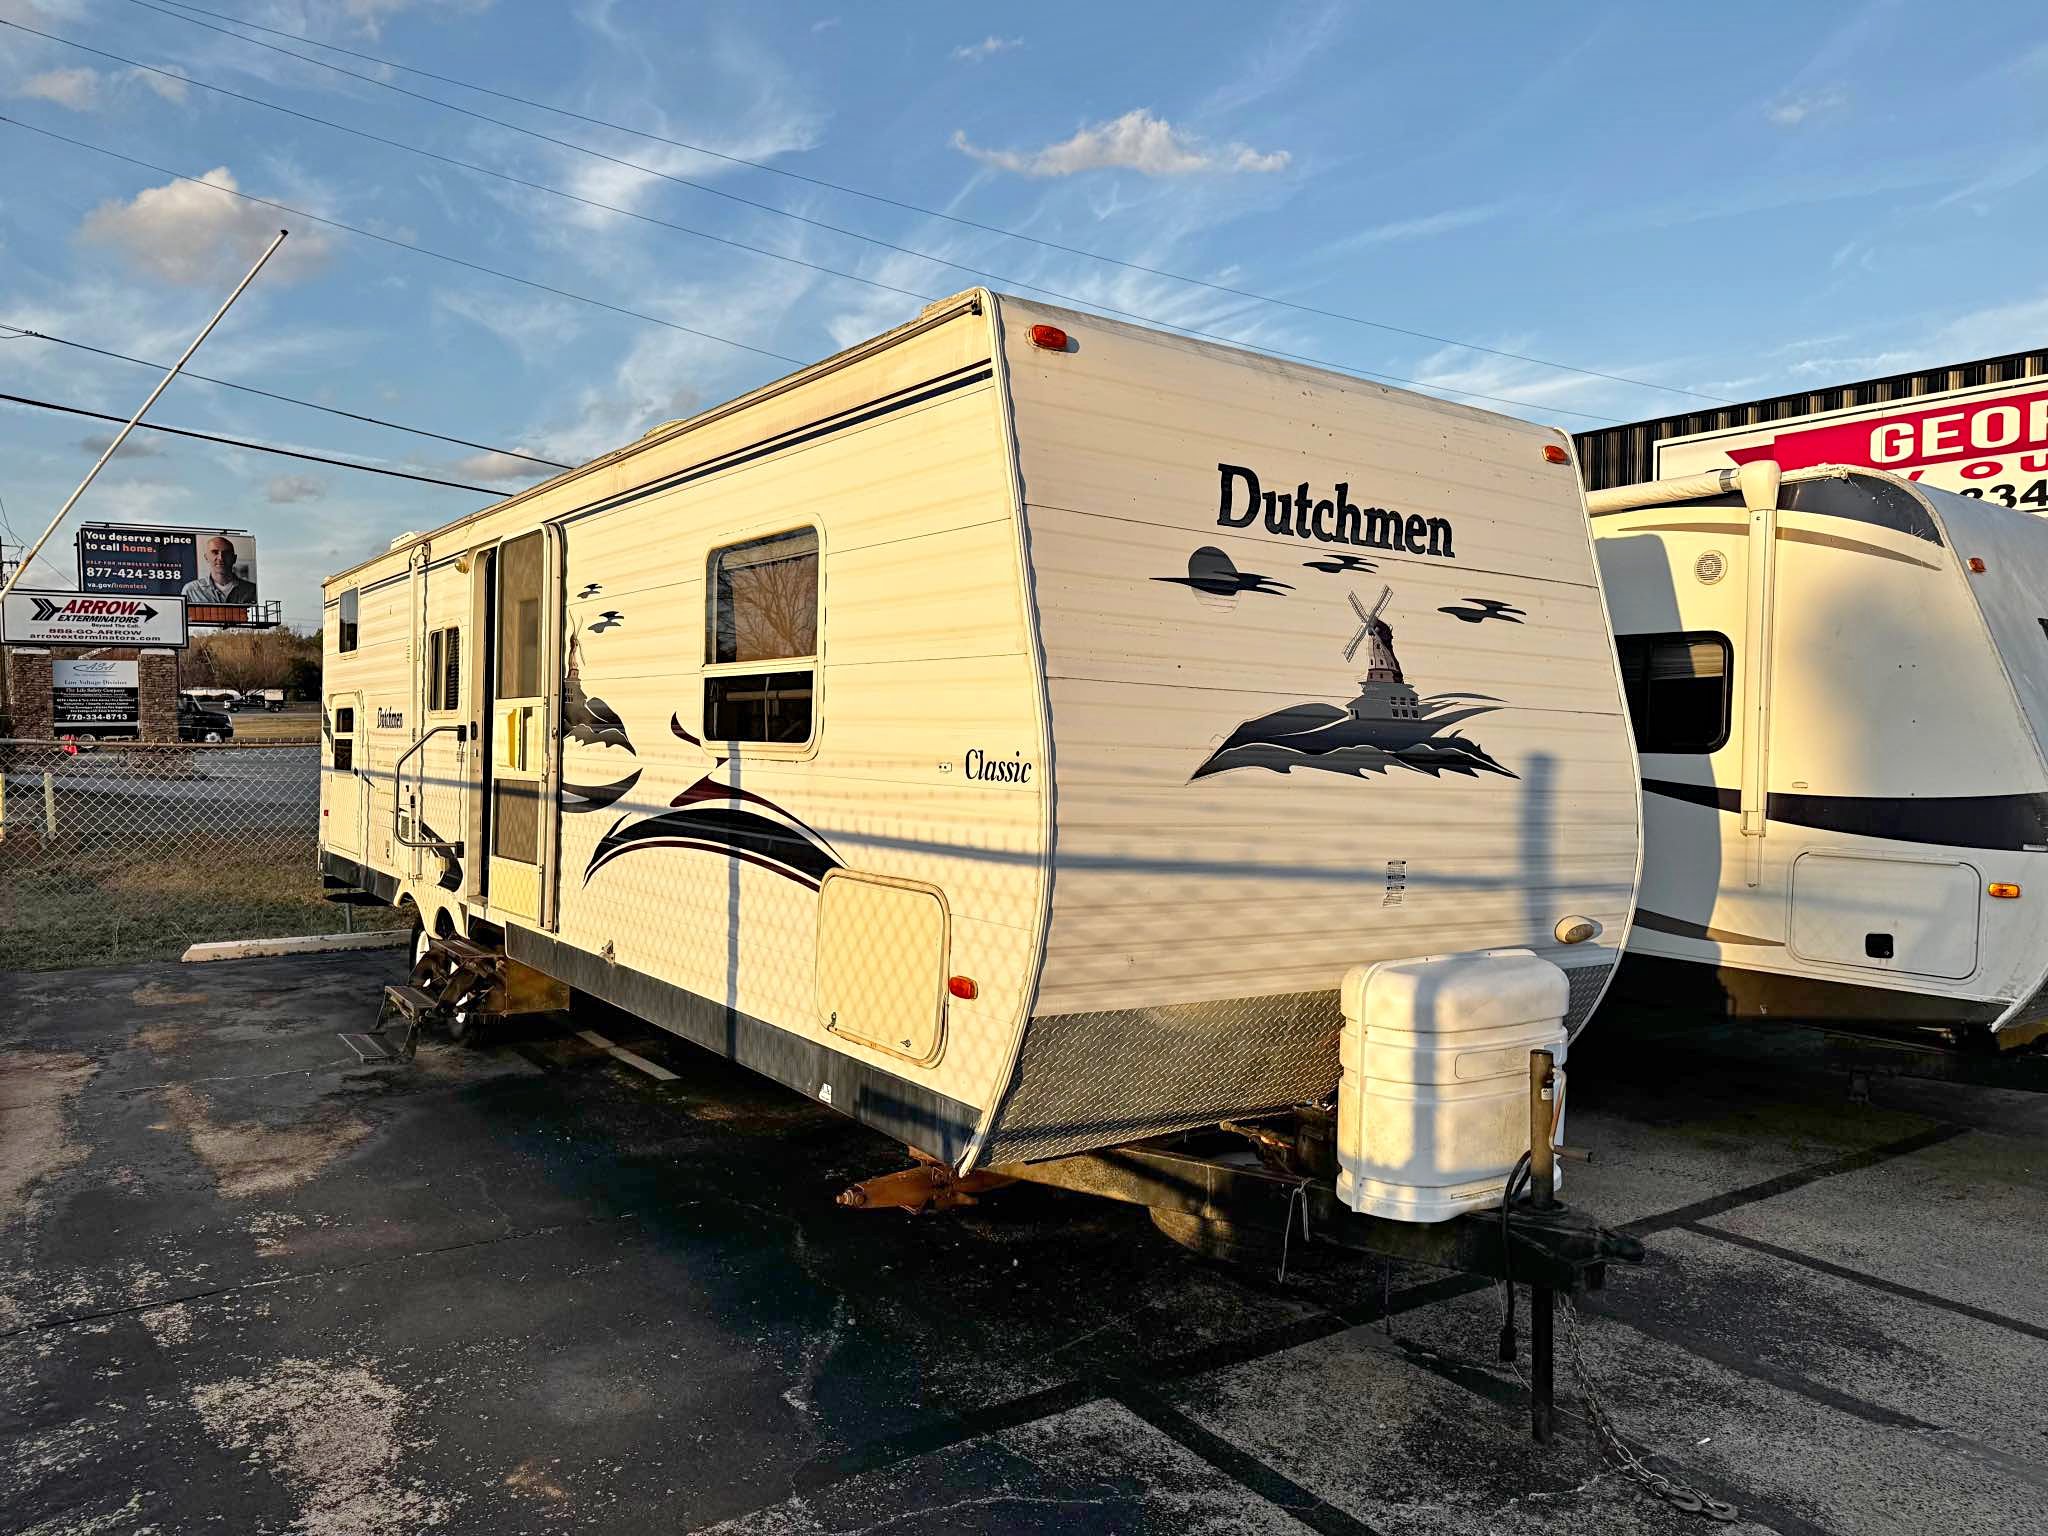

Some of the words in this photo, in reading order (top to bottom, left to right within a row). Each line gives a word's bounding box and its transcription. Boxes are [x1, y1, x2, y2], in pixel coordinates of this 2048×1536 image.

[1217, 463, 1455, 558] Dutchmen
[86, 531, 106, 540] You
[109, 532, 152, 543] deserve
[163, 535, 192, 545] place
[86, 542, 98, 550] to
[100, 543, 120, 552] call
[122, 544, 157, 553] home.
[86, 567, 181, 580] 877-424-3838
[87, 582, 148, 590] va.gov/homeless
[61, 600, 142, 615] ARROW
[57, 614, 140, 624] EXTERMINATORS
[29, 633, 161, 641] arrowexterminators.com
[49, 628, 142, 636] 888-GO-ARROW
[965, 749, 1032, 783] Classic
